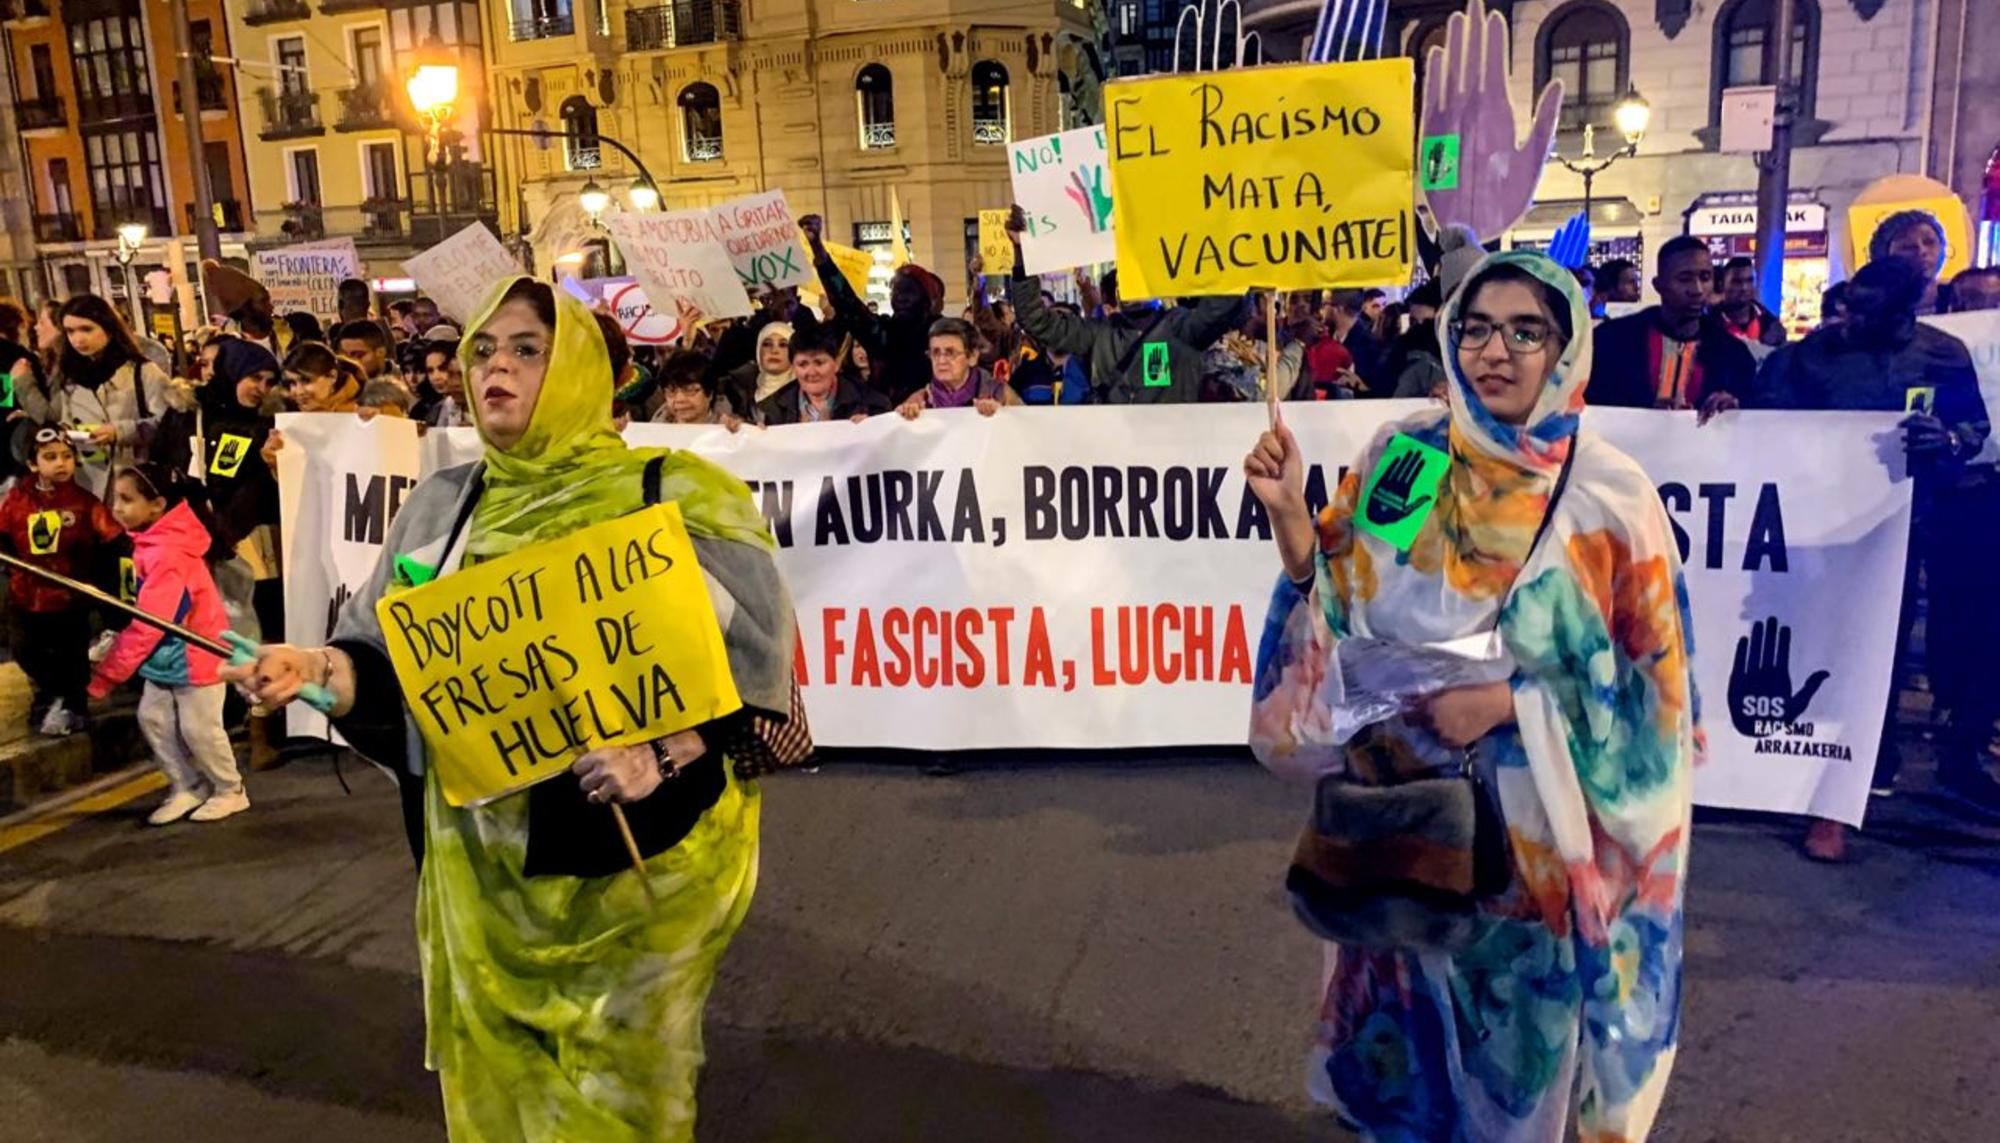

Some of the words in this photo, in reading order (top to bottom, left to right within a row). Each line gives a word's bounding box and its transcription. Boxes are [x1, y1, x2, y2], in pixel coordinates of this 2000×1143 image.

[1115, 97, 1170, 160] EL
[1016, 136, 1062, 174] NO!
[1203, 172, 1333, 214] MATA,
[734, 246, 801, 285] VOX
[814, 467, 1007, 547] AURKA,
[1022, 464, 1273, 542] BORROKA
[389, 566, 546, 671] BOYCOTT
[419, 634, 579, 736] FRESAS
[595, 610, 655, 665] DE
[822, 606, 1077, 692] FASCISTA,
[1090, 602, 1253, 686] LUCHA
[490, 663, 686, 777] HUELVA
[1742, 695, 1786, 718] SOS
[1754, 719, 1815, 737] RACISMO
[1754, 739, 1853, 762] ARRAZAKERIA
